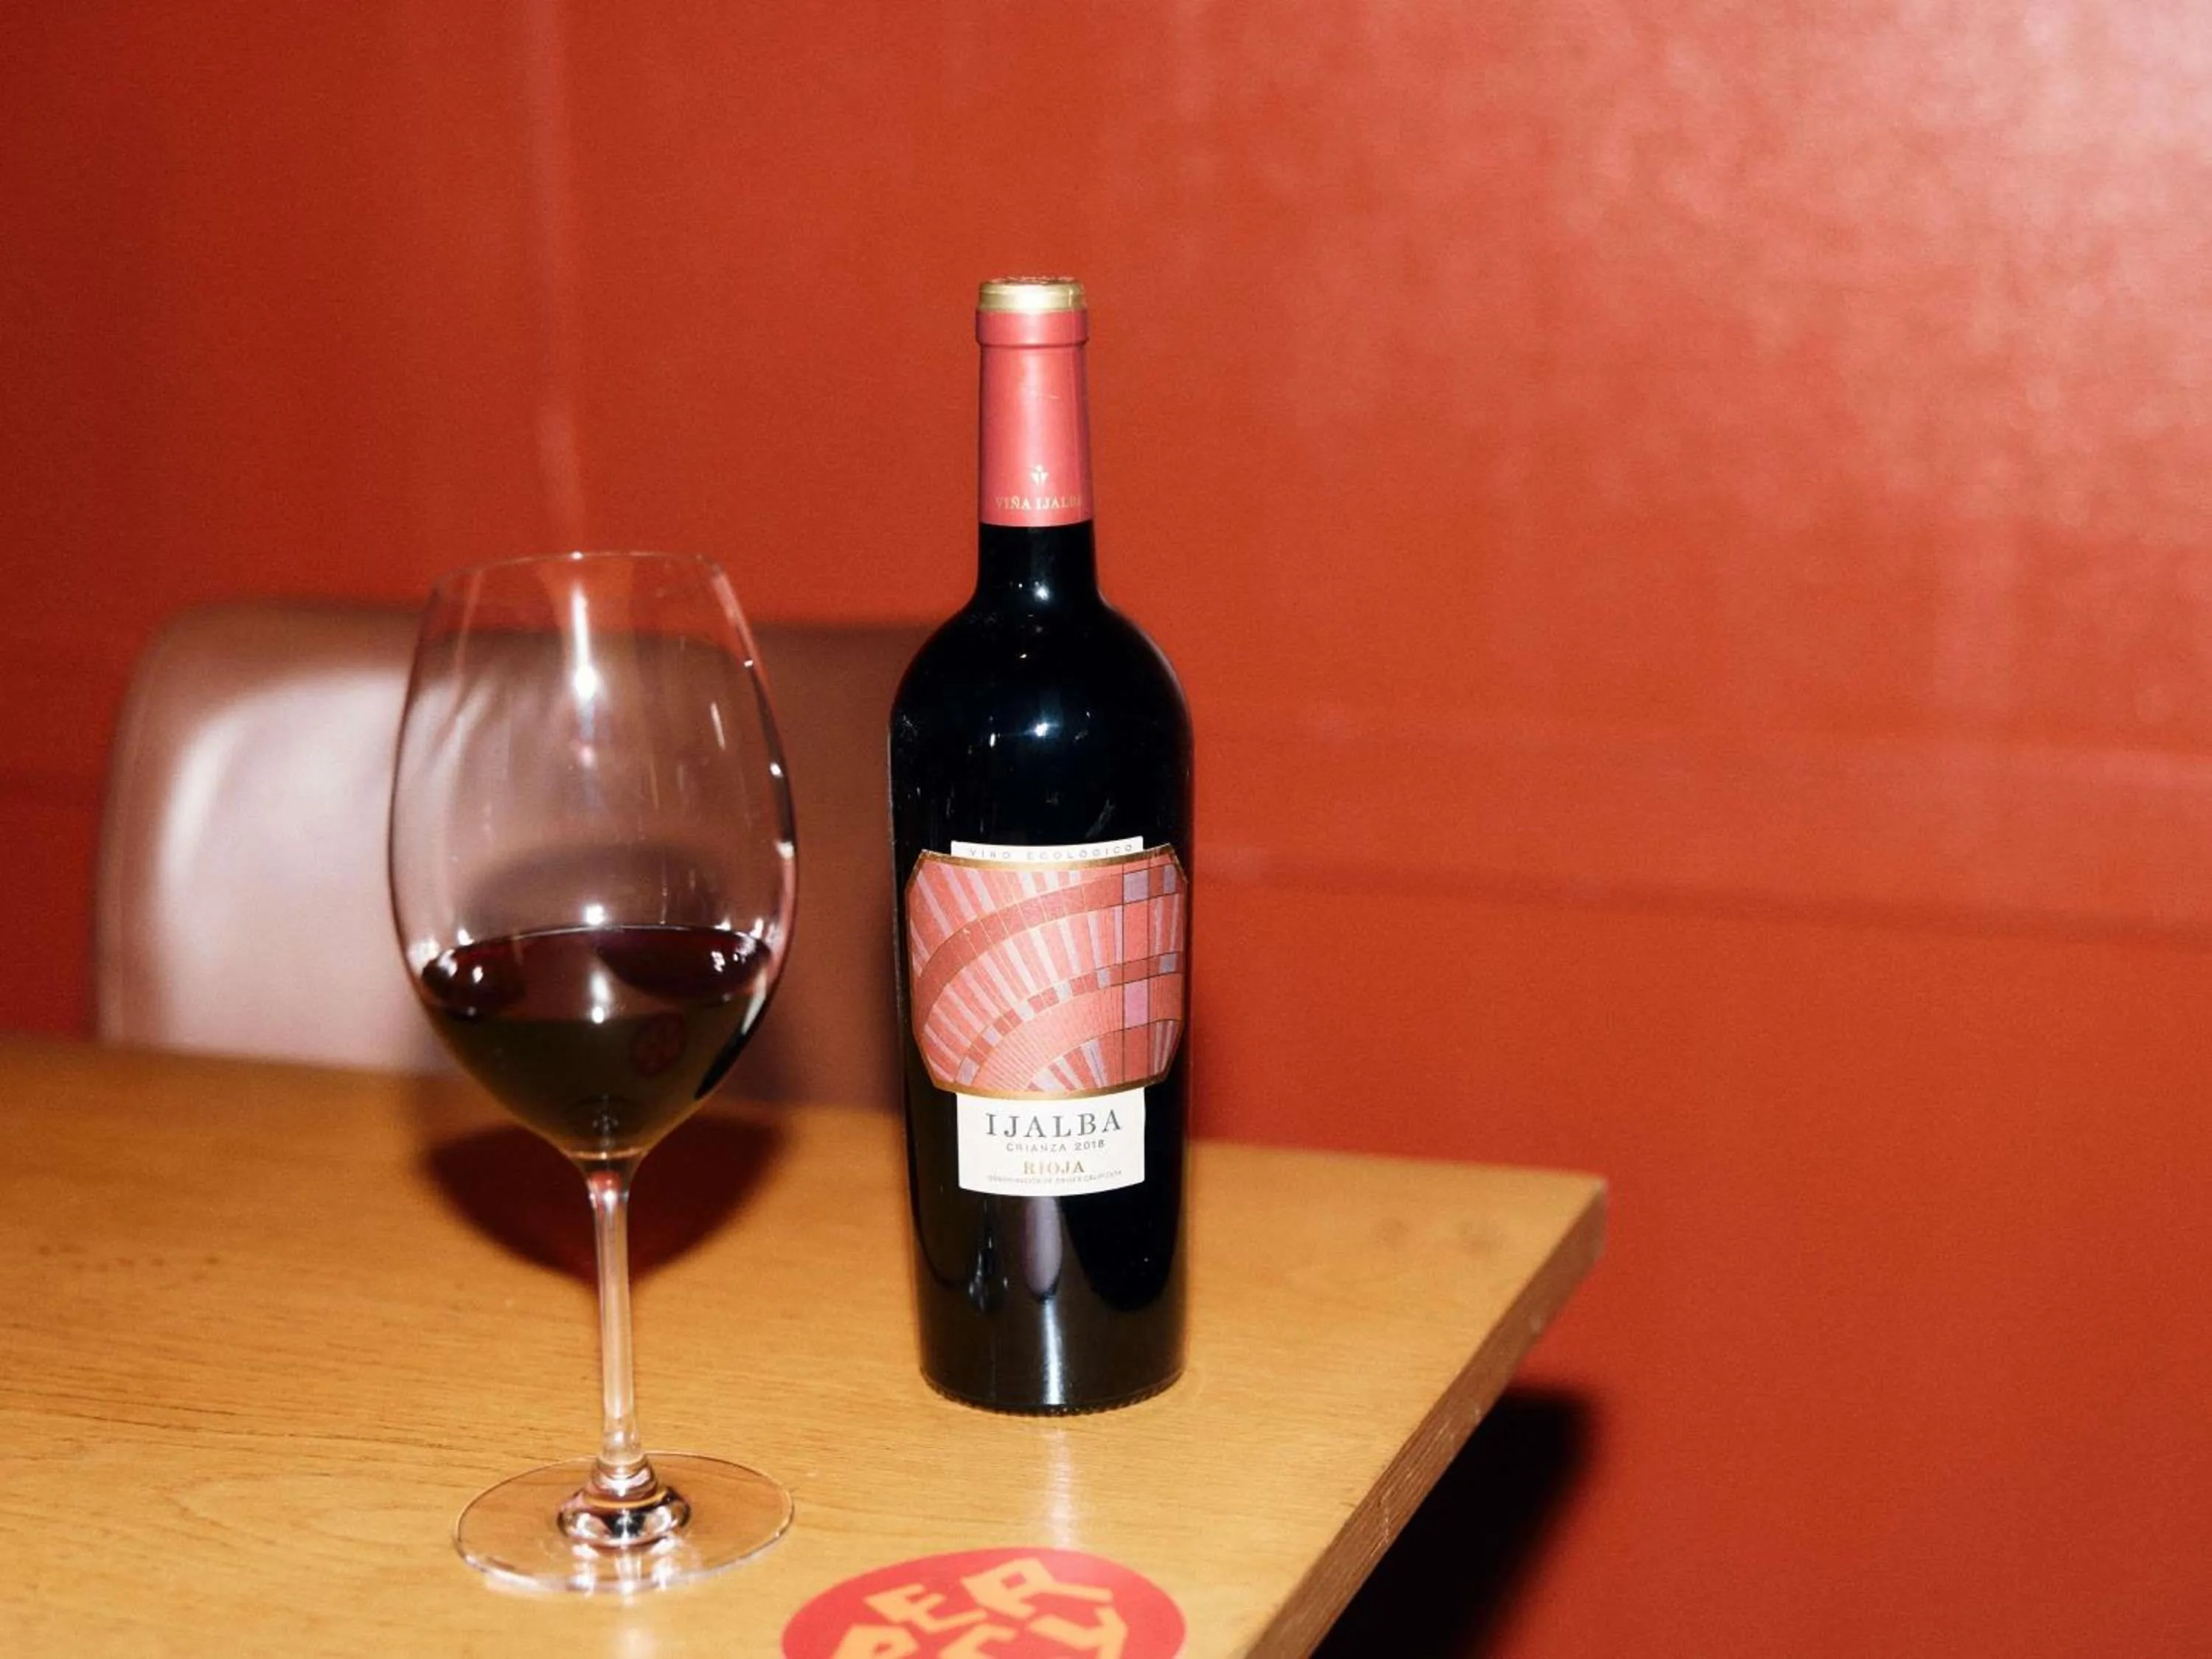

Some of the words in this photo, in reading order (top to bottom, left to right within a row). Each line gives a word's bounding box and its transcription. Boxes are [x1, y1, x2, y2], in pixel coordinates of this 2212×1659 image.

[995, 495, 1031, 510] VIÑA
[968, 847, 1011, 860] VINO
[986, 1109, 1122, 1138] IJALBA
[1006, 1142, 1067, 1152] CRIANZA
[1074, 1139, 1105, 1151] 2018
[1024, 1161, 1085, 1175] RIOJA
